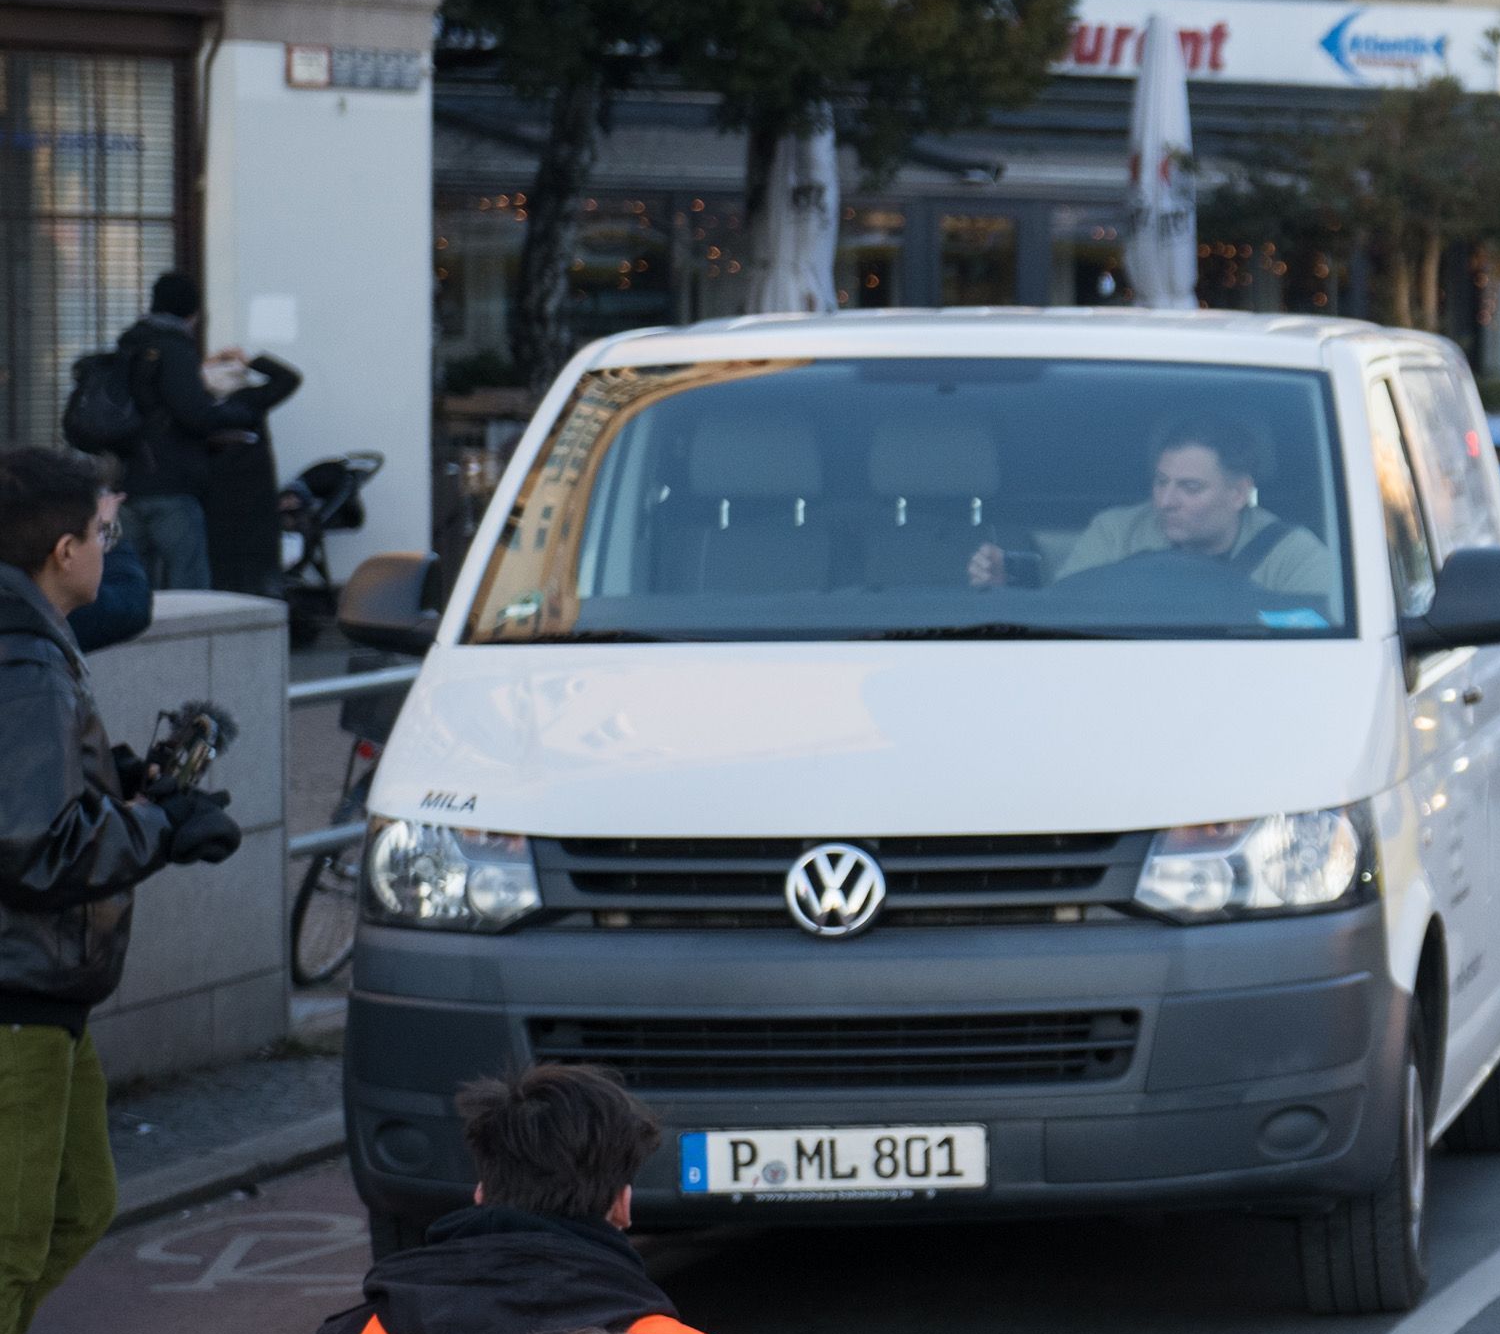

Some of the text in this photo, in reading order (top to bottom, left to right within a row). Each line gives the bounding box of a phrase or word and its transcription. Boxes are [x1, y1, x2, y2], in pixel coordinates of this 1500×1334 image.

[420, 790, 477, 813] MILA
[729, 1136, 964, 1182] P ML 801
